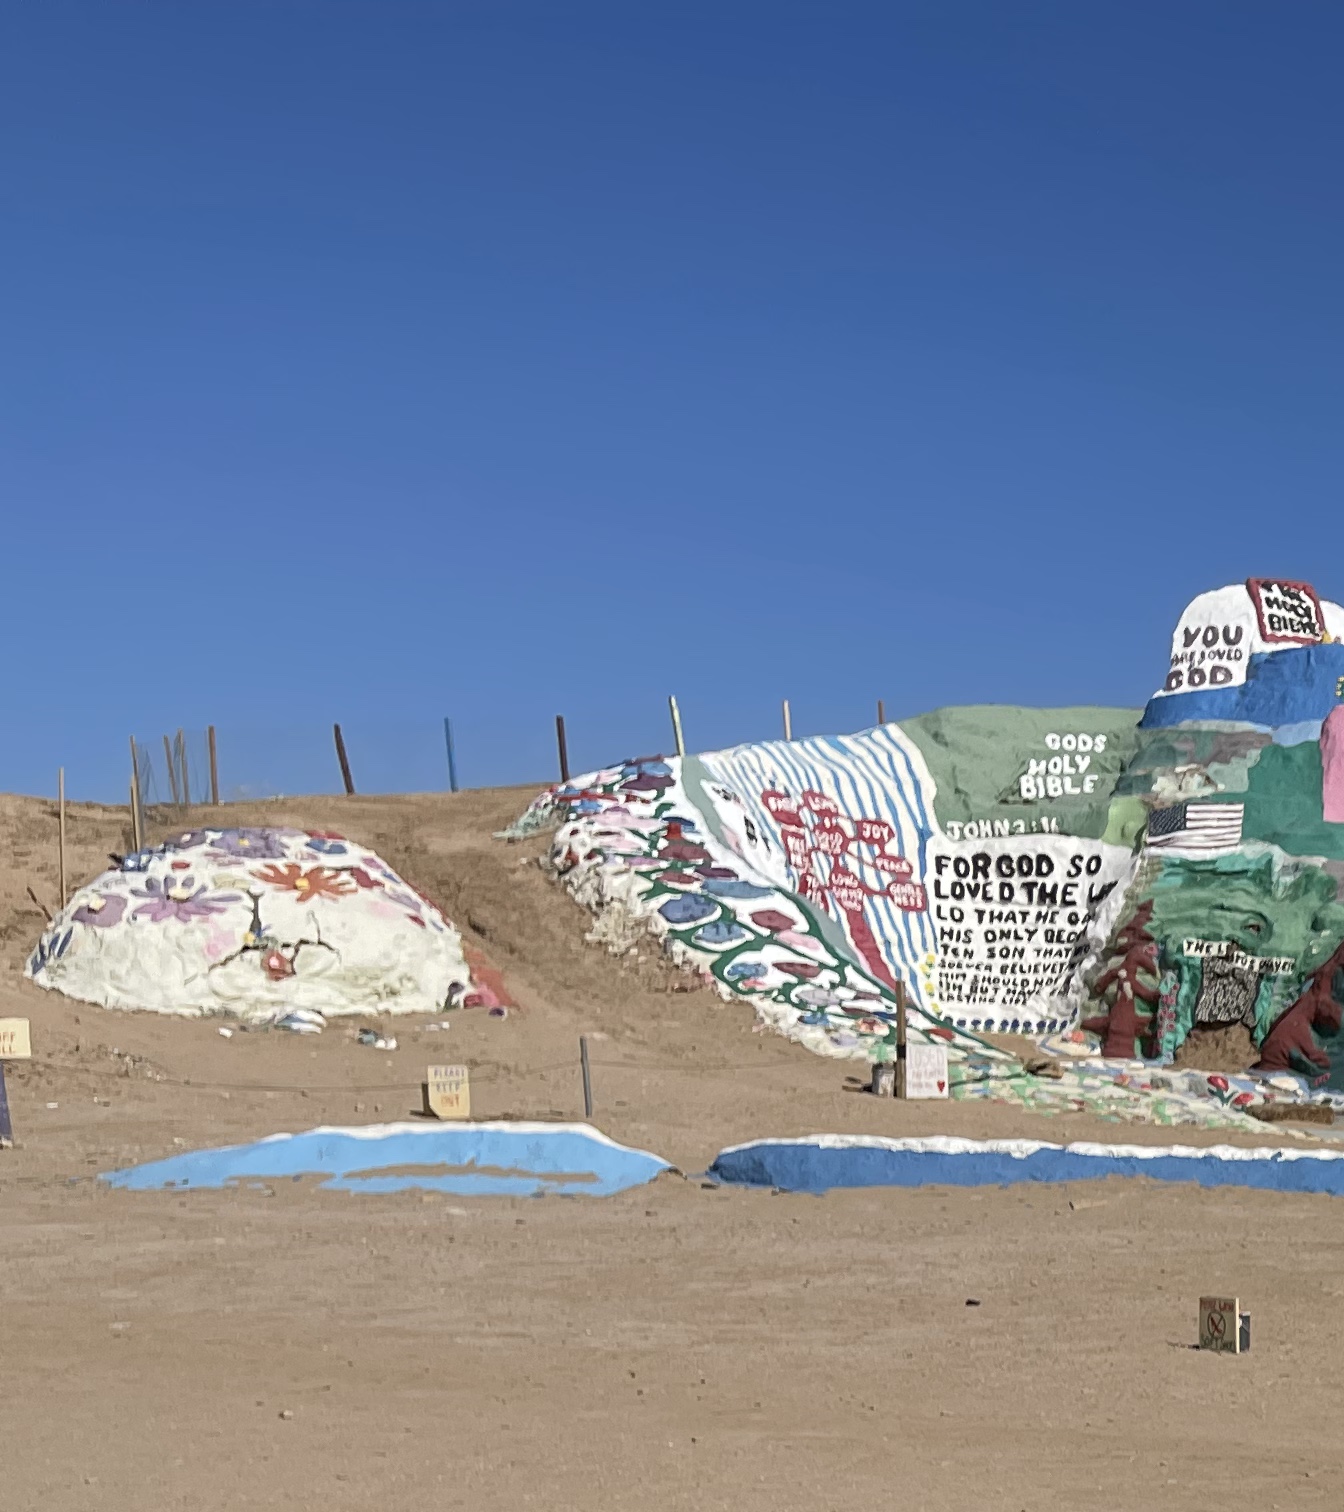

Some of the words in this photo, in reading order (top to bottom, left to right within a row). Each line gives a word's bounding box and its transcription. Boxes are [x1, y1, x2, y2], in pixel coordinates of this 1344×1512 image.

[1183, 624, 1243, 648] YOU
[1165, 664, 1233, 691] GOD
[1045, 732, 1107, 753] GODS
[1027, 754, 1091, 776] HOLY
[1020, 774, 1099, 800] BIBLE
[862, 821, 891, 843] JOY
[946, 818, 1010, 841] JOHN
[935, 852, 992, 880] FOR
[995, 853, 1055, 878] GOD
[1066, 854, 1103, 878] SO
[934, 878, 1016, 902] LOVED
[1020, 880, 1079, 906] THE
[973, 907, 1030, 925] THAT
[939, 925, 974, 944] HIS
[983, 927, 1038, 942] ONLY
[940, 943, 974, 959] TEN
[986, 945, 1025, 960] SON
